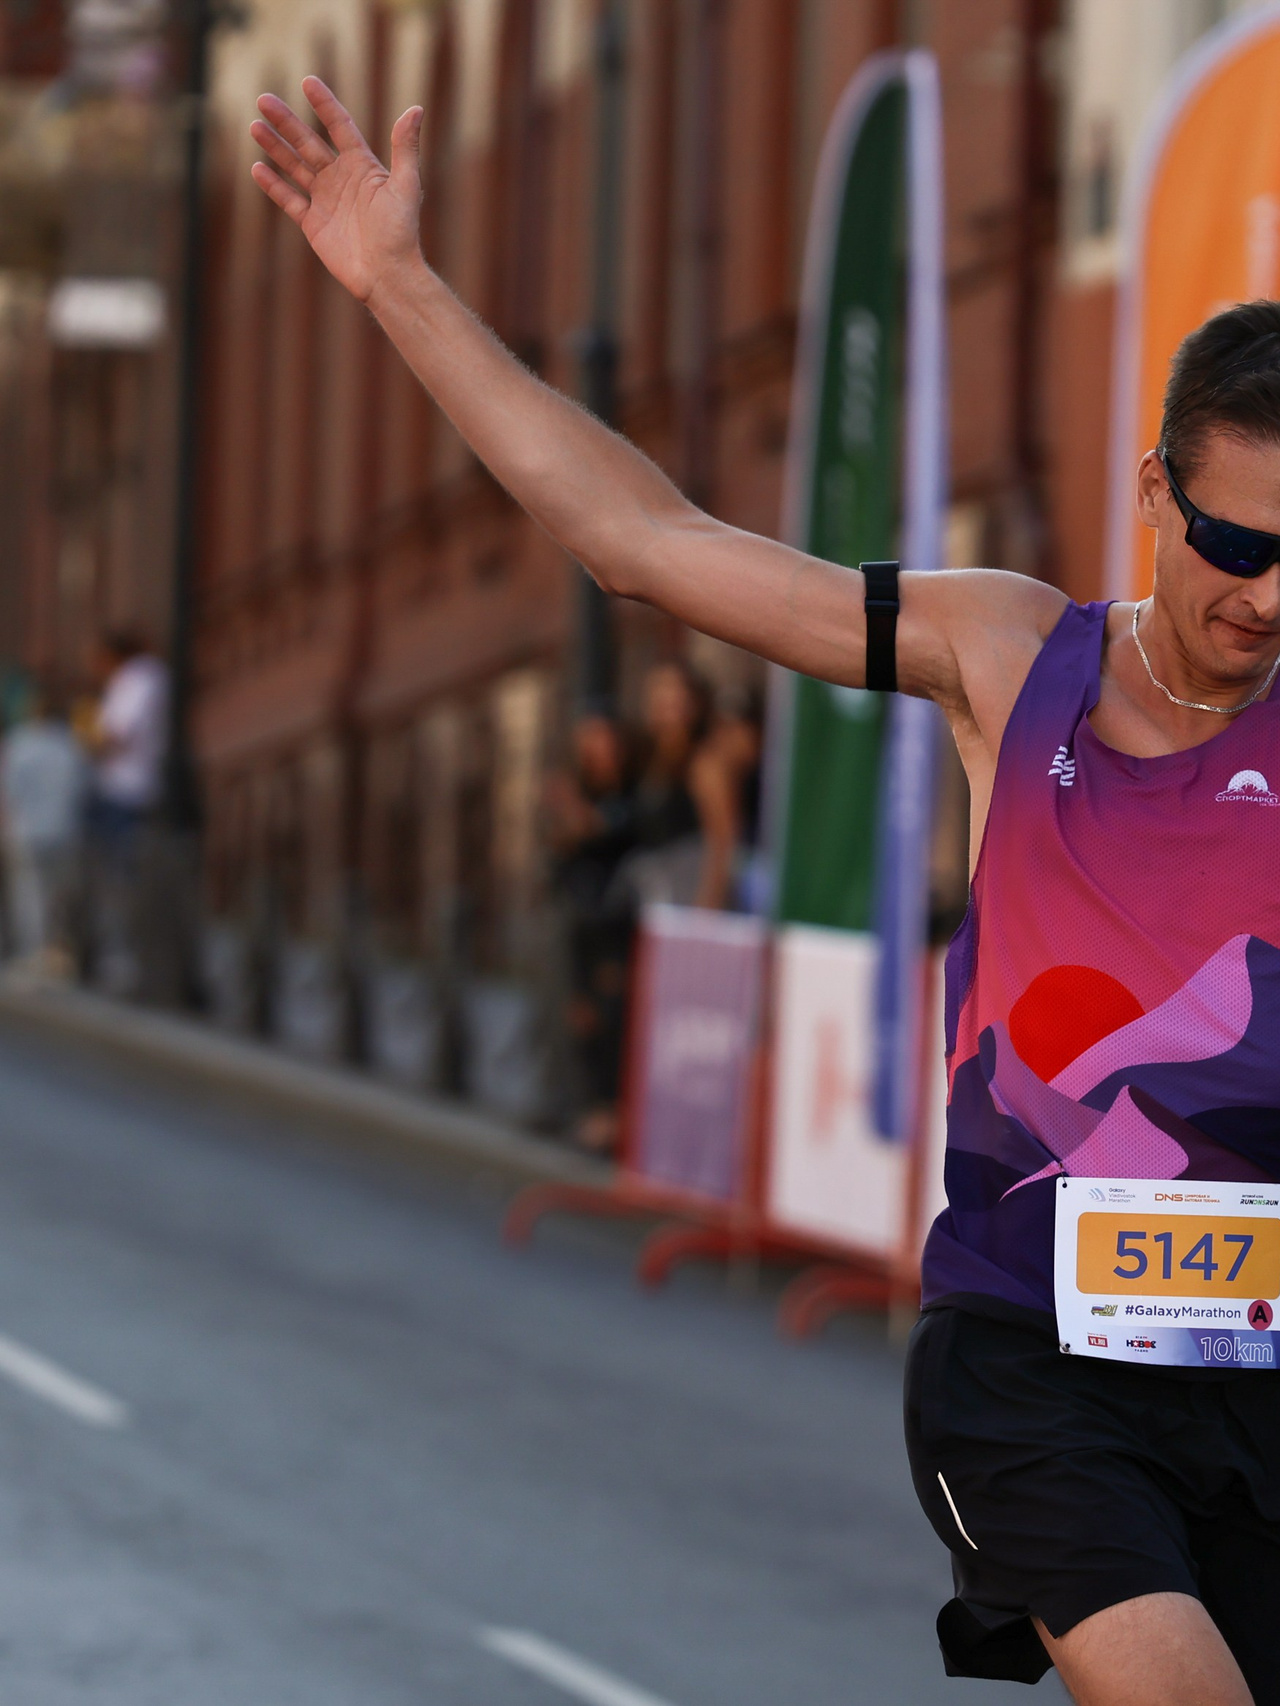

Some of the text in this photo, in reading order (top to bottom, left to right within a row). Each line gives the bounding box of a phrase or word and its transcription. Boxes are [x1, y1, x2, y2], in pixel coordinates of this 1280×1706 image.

[1154, 1193, 1184, 1202] DNS
[1113, 1231, 1254, 1281] 5147
[1125, 1304, 1241, 1319] #GalaxyMarathon
[1252, 1305, 1269, 1323] A
[1200, 1336, 1273, 1362] 10km
